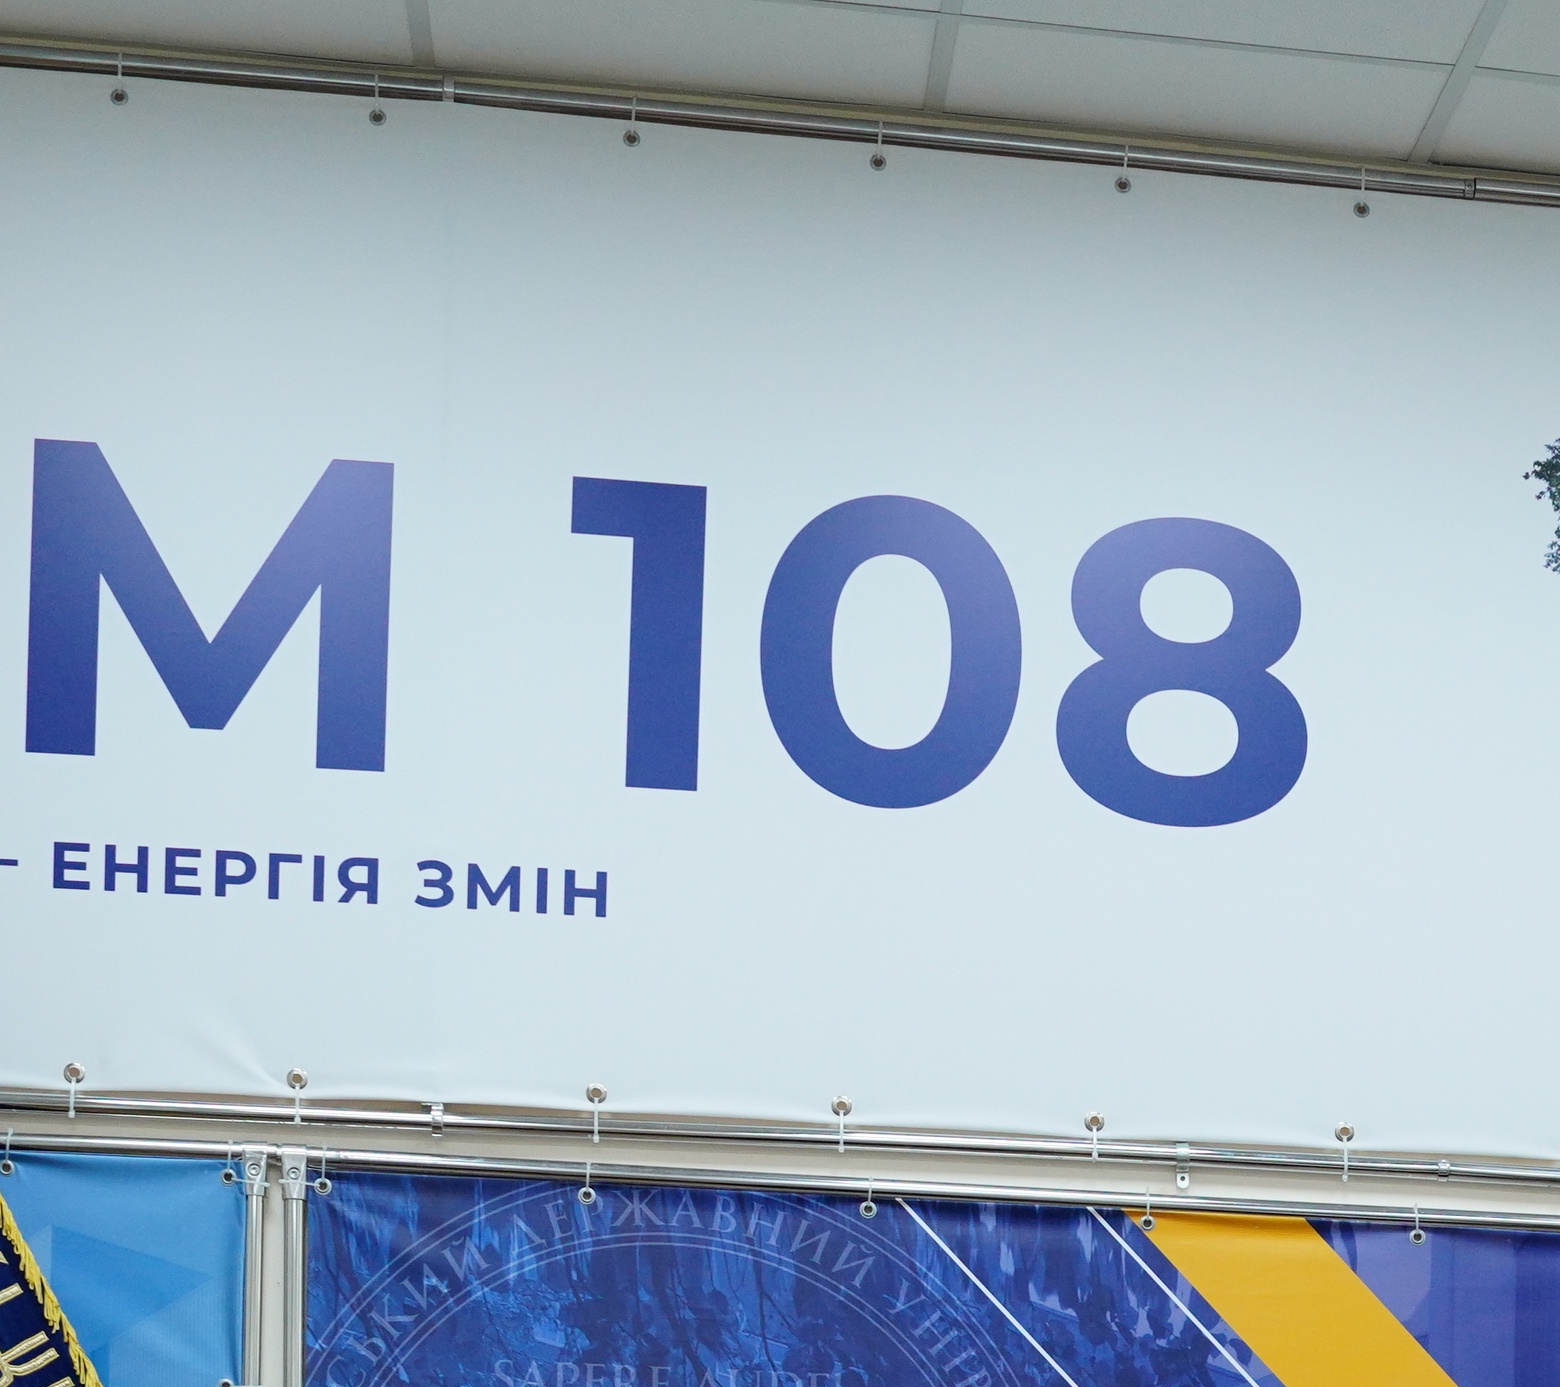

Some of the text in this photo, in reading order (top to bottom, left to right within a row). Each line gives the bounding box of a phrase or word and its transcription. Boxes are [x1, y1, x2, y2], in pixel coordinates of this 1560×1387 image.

[570, 476, 1308, 828] 108
[52, 841, 379, 905] ЕНЕРГІЯ
[414, 860, 608, 918] ЗМІН
